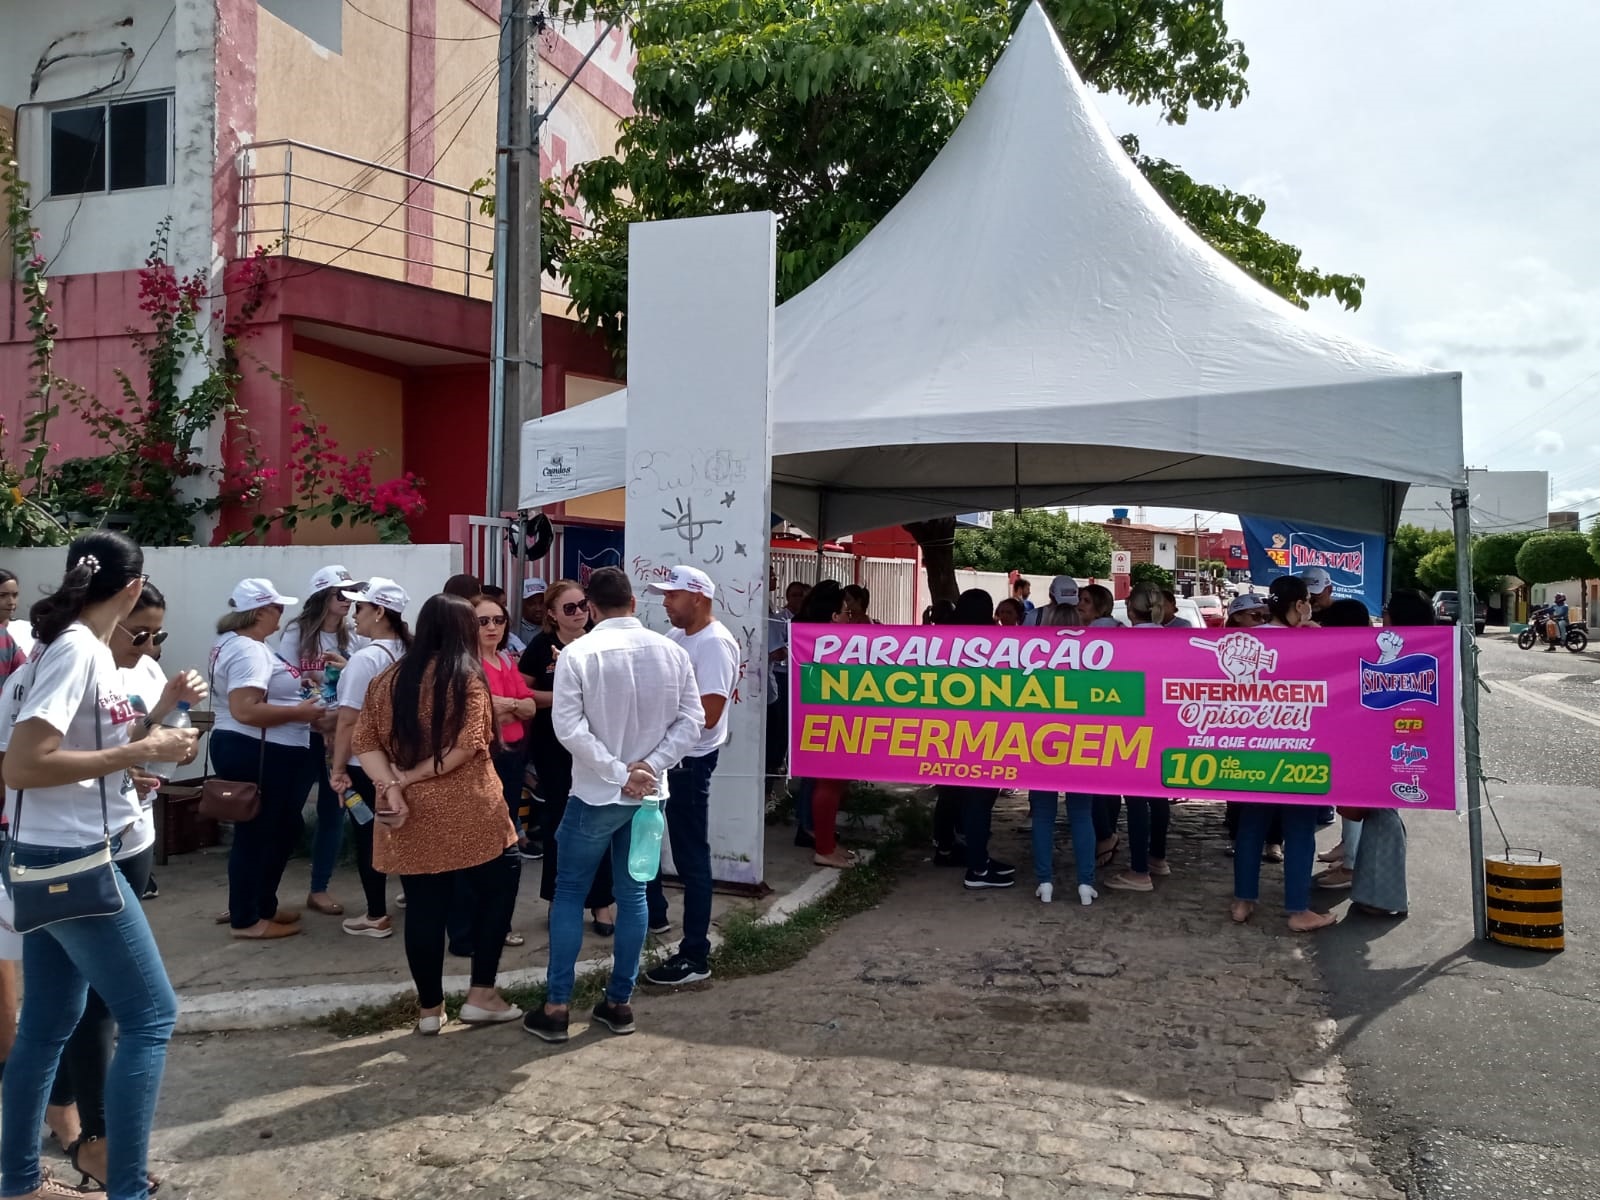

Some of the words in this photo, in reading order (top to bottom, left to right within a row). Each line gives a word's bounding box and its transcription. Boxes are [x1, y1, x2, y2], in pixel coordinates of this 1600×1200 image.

[813, 629, 1114, 676] PARALISAÇÃO
[820, 669, 1079, 709] NACIONAL
[1090, 687, 1122, 703] DA
[1165, 682, 1324, 704] ENFERMAGEM
[1363, 669, 1436, 696] SINFEMP
[1181, 702, 1200, 724] O
[1201, 705, 1253, 731] piso
[1257, 705, 1272, 726] é
[1274, 704, 1310, 728] lei!
[1394, 719, 1424, 730] CTB
[800, 714, 1153, 769] ENFERMAGEM
[1187, 735, 1215, 747] TEM
[1218, 736, 1246, 748] QUE
[1249, 737, 1316, 751] CUMPRIR!
[918, 761, 1018, 781] PATOS-PB
[1167, 753, 1218, 786] 10
[1220, 756, 1240, 769] de
[1219, 768, 1266, 782] março
